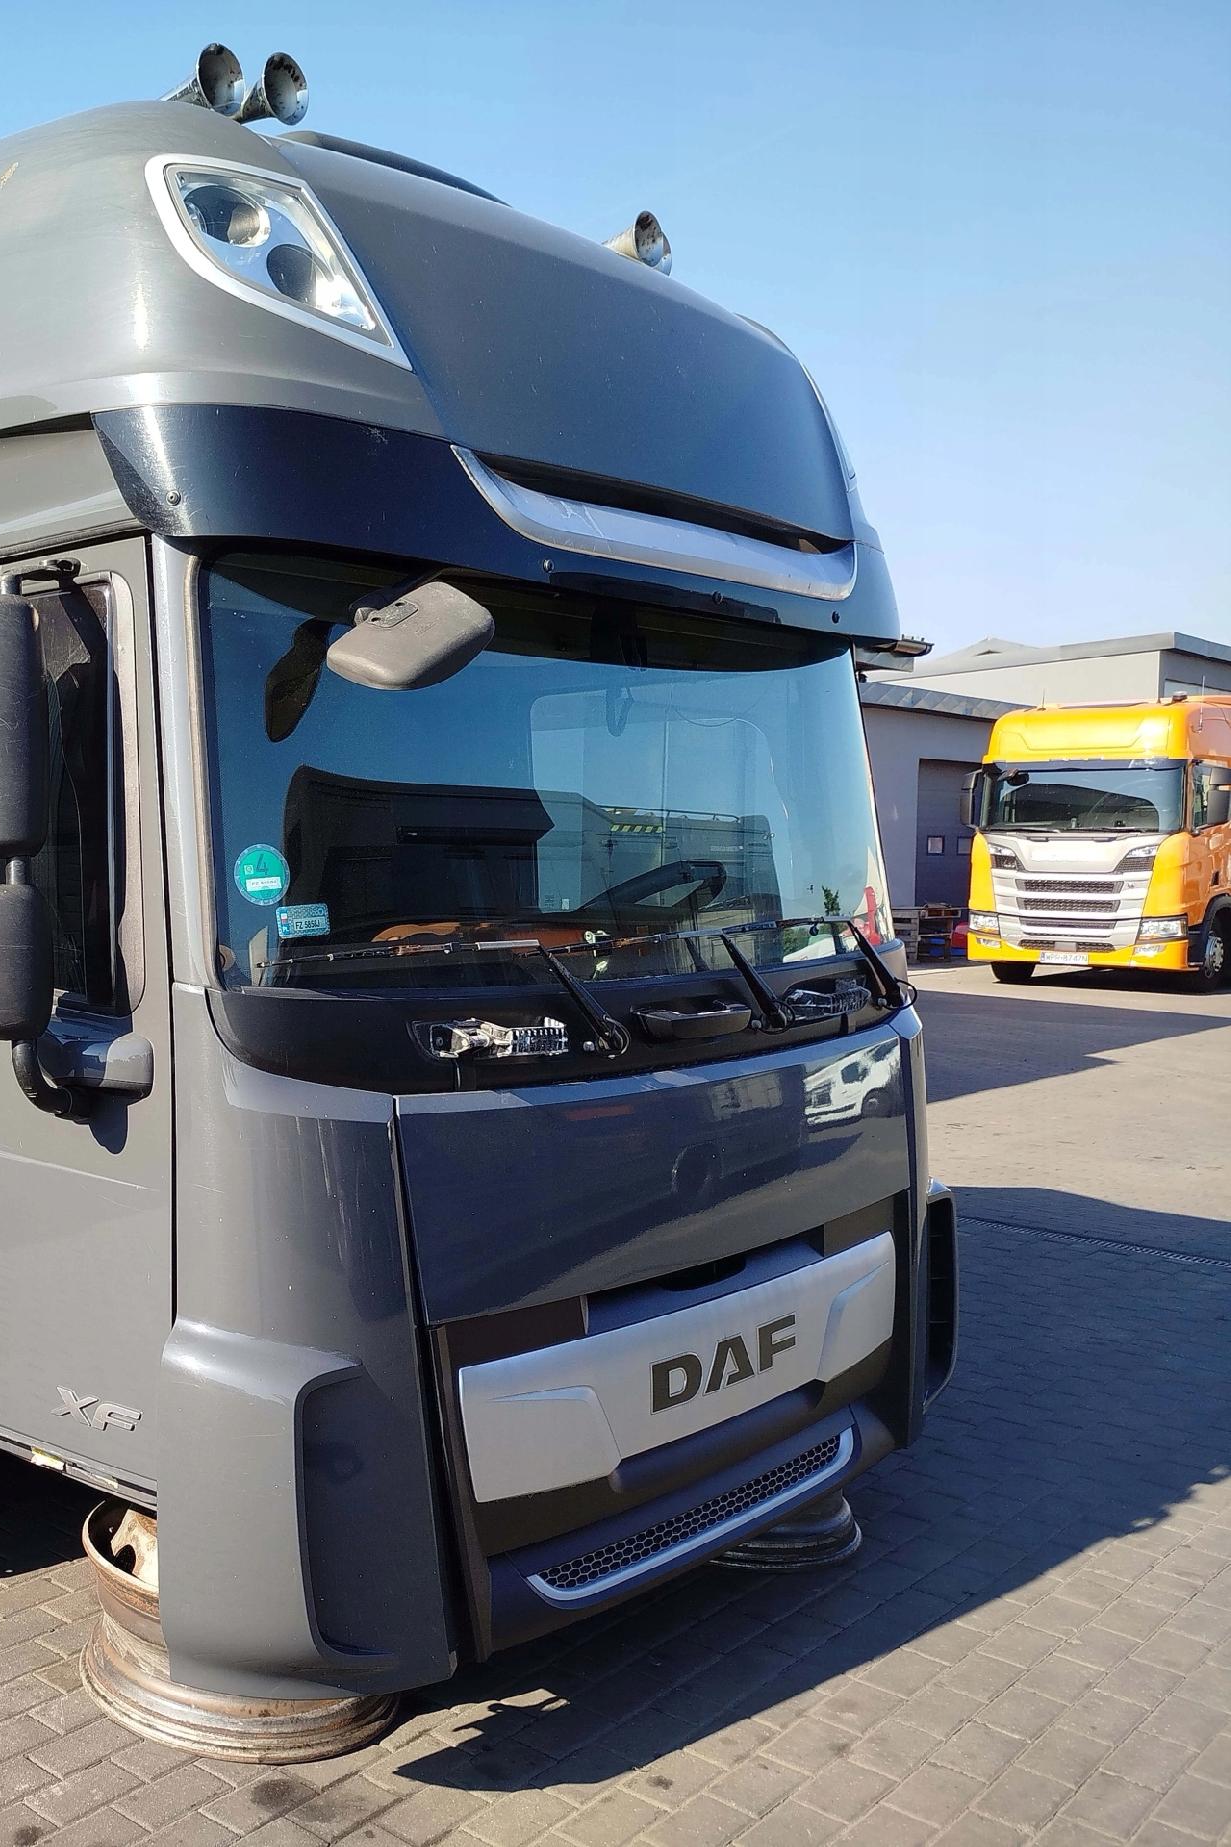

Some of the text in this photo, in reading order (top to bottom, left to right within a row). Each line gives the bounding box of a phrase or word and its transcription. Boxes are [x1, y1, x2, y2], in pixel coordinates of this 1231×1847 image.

[256, 853, 269, 876] 4
[650, 1312, 797, 1415] DAF
[49, 1385, 143, 1432] XF
